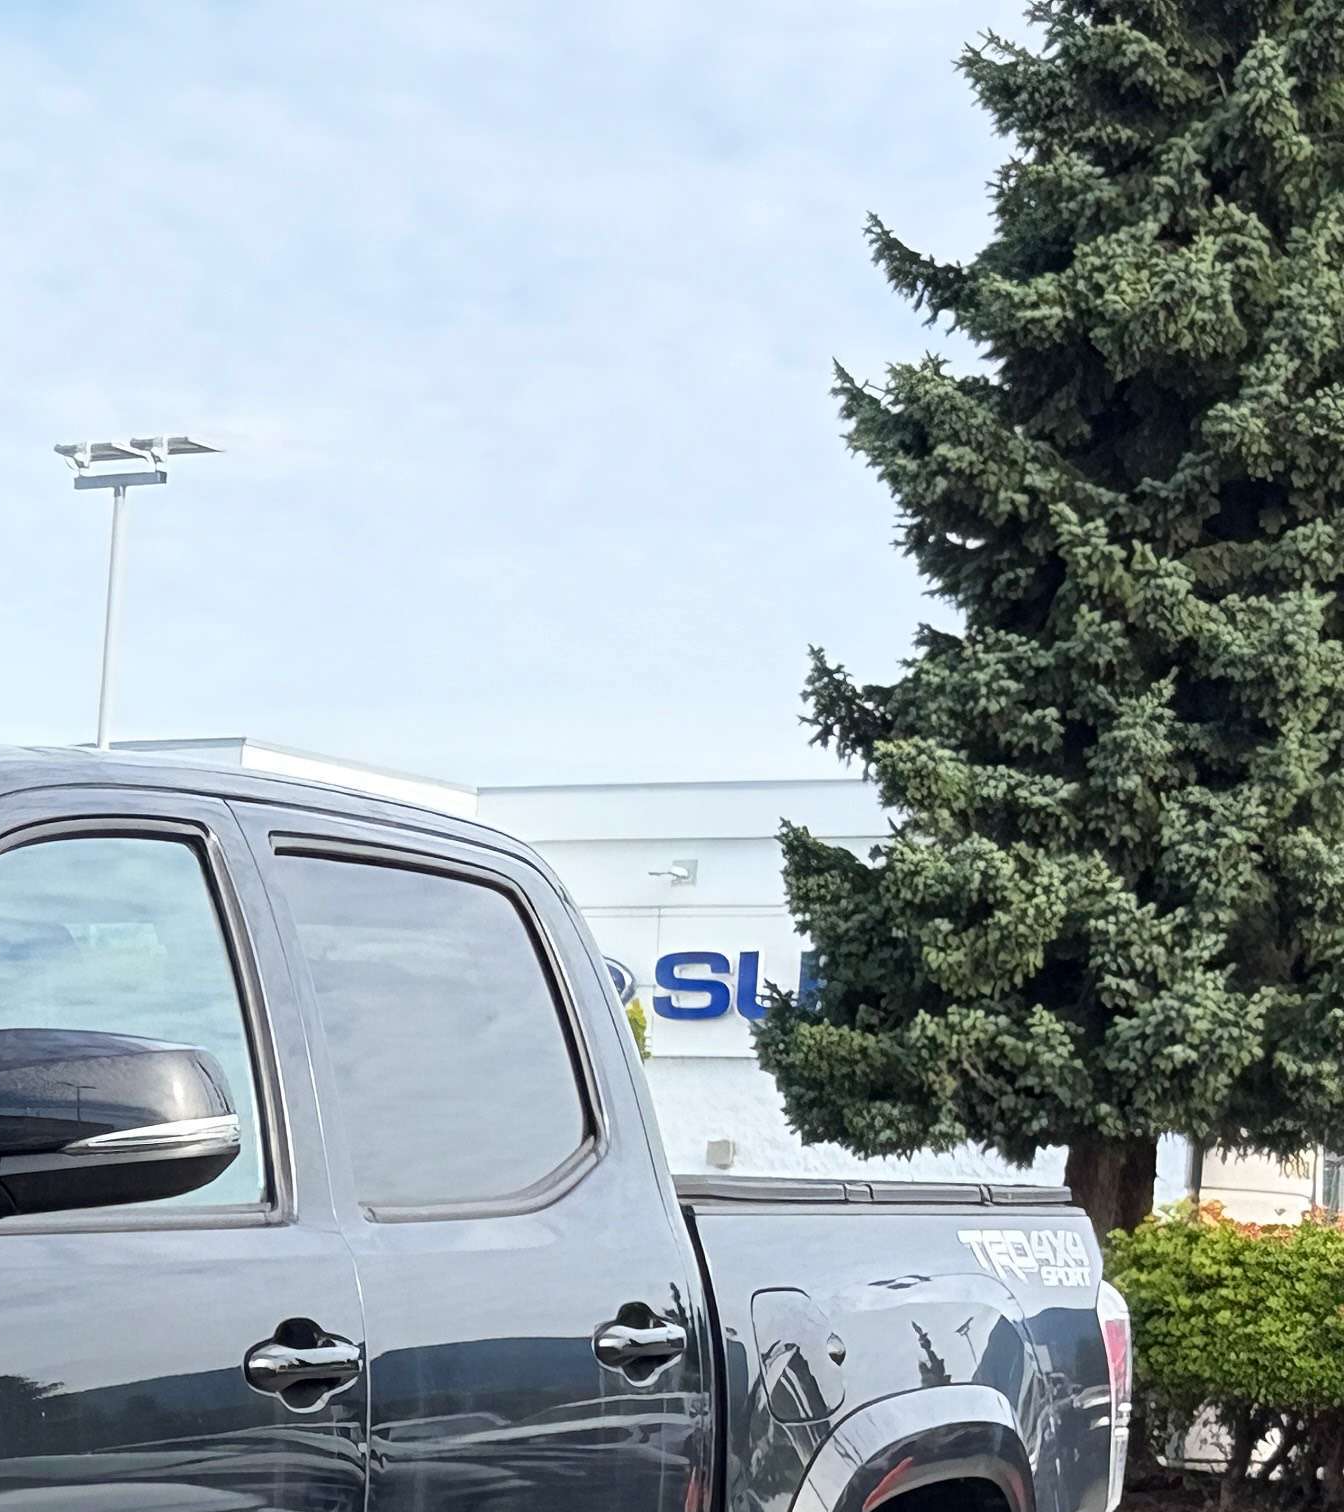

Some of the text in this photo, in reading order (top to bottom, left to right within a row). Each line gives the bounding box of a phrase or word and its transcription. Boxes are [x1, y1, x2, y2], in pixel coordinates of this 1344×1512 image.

[653, 950, 819, 1021] SU
[957, 1230, 1039, 1284] TRD
[1040, 1266, 1091, 1287] SPORT
